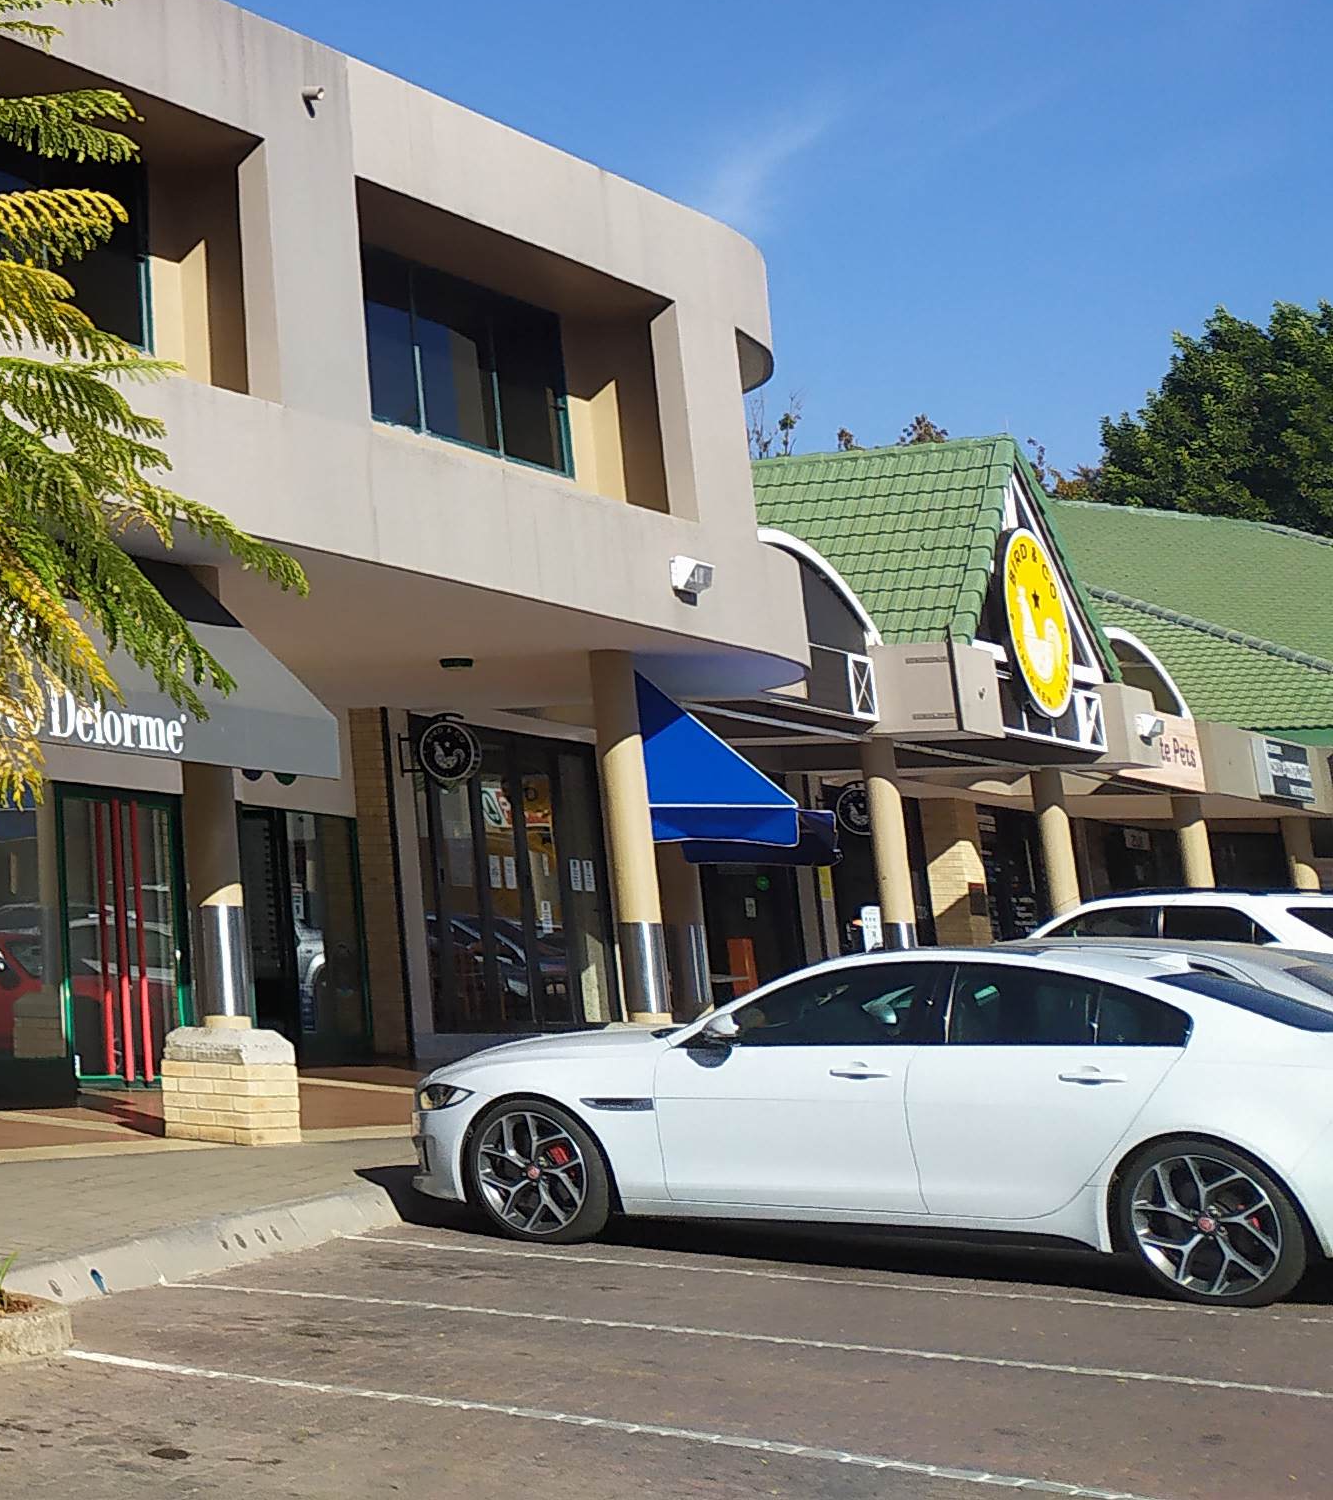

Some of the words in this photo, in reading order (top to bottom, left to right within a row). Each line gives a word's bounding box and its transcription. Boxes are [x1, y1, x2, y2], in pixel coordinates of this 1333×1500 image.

[1008, 543, 1027, 588] BIRD
[1042, 563, 1057, 600] CO
[1173, 737, 1197, 768] Pets
